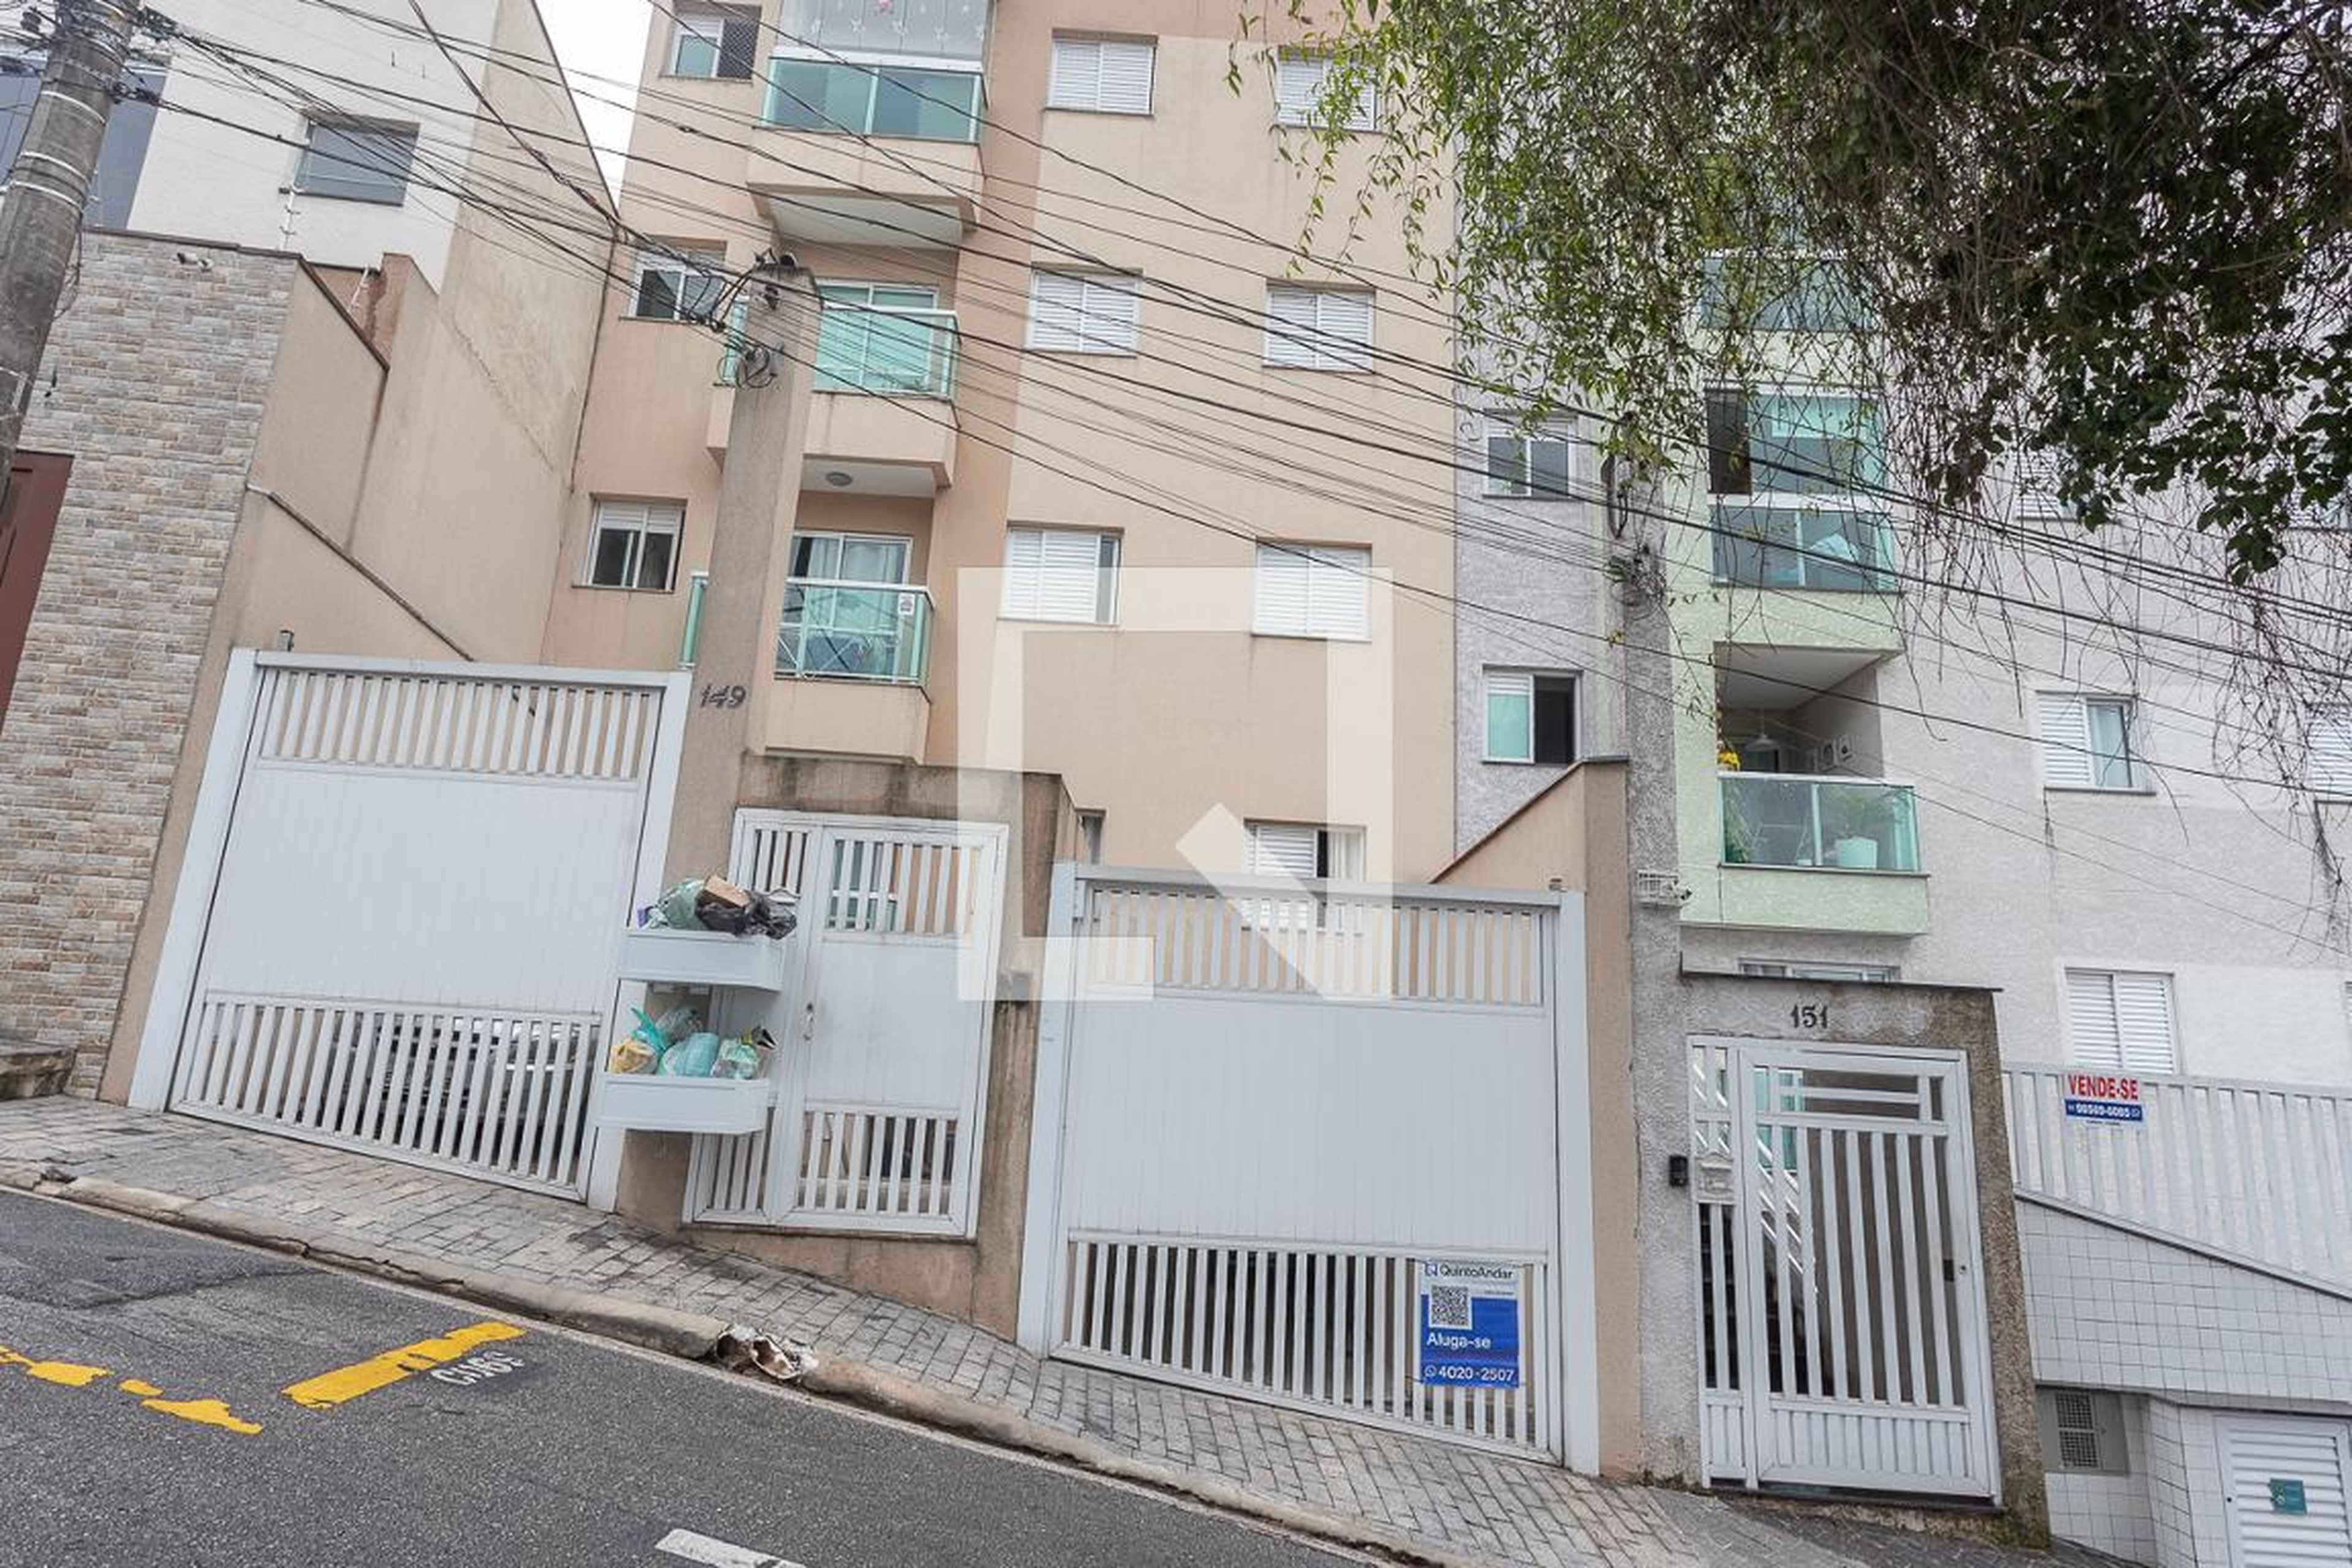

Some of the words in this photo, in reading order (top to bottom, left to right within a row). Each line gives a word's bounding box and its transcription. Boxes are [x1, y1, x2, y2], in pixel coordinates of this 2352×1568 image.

[701, 684, 746, 708] 149
[1790, 1005, 1828, 1028] 151
[2068, 1074, 2138, 1100] VENDE-SE
[1439, 1264, 1513, 1279] QuintoAndar
[1426, 1332, 1491, 1349] Aluga-se
